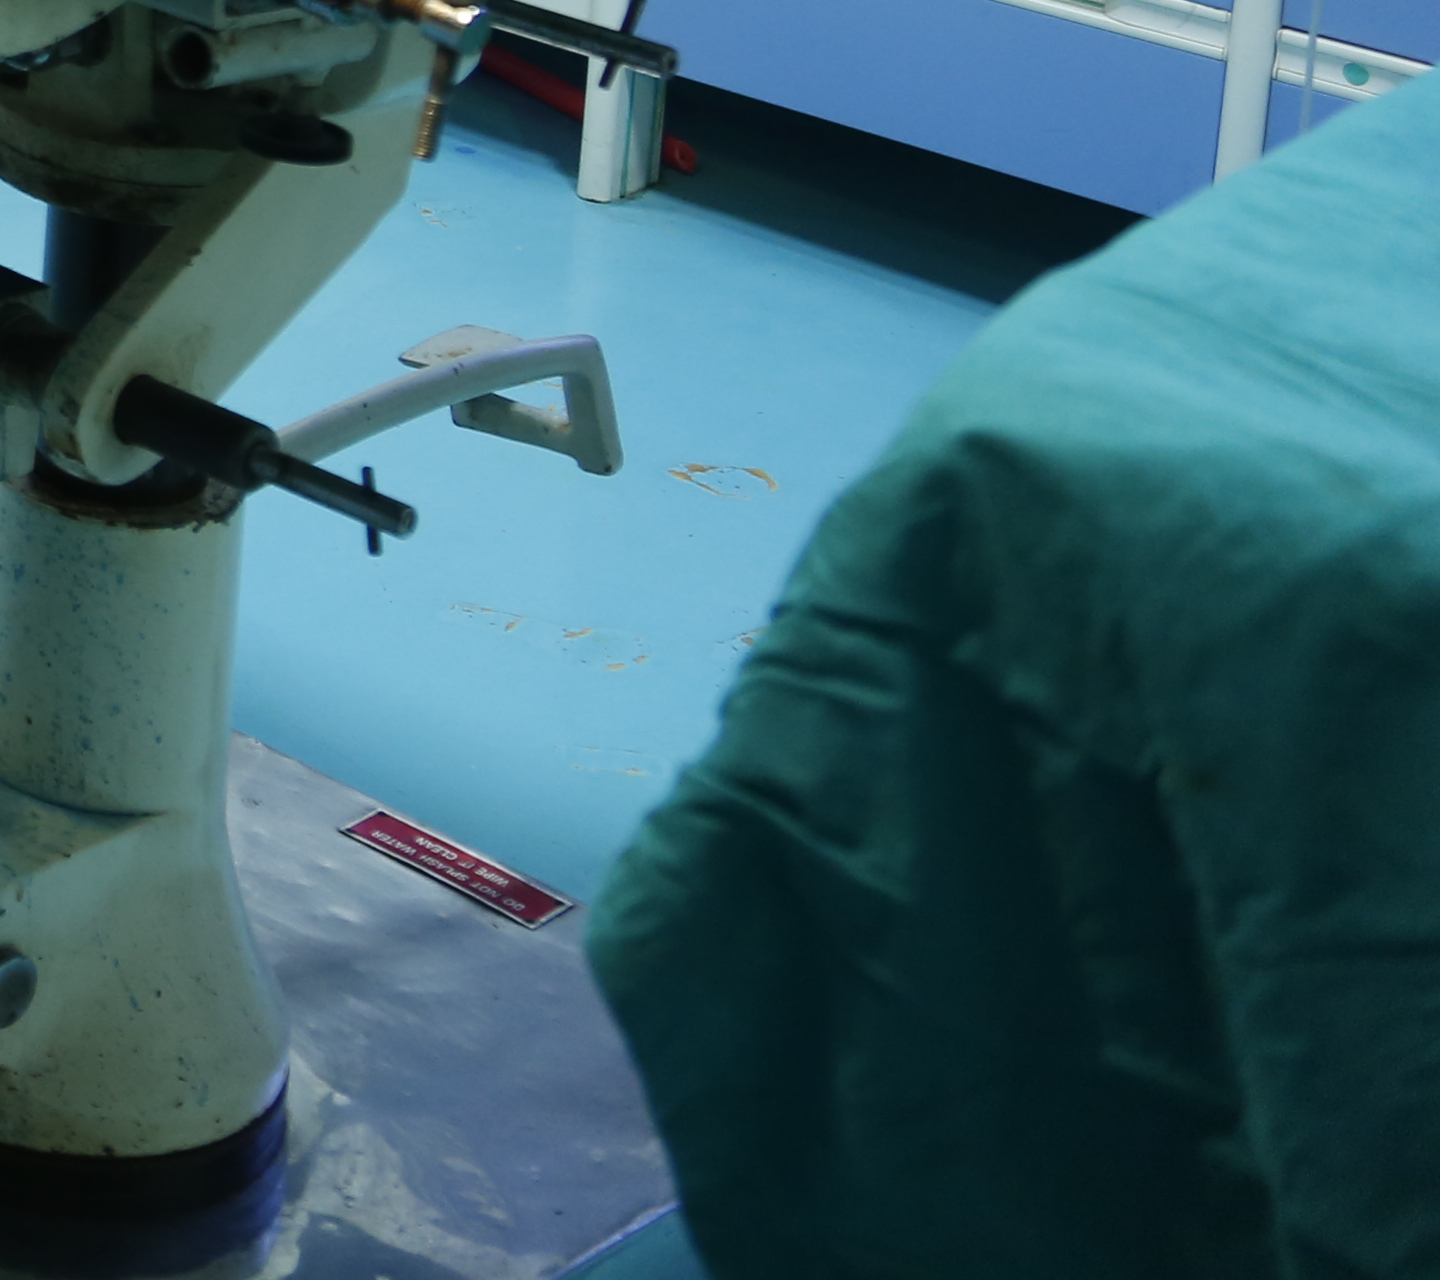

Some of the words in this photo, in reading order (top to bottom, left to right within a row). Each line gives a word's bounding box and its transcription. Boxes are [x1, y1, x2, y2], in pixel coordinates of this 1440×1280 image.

[371, 830, 417, 856] WATER
[415, 836, 458, 861] CLEAN
[418, 854, 470, 882] SPLASH
[474, 867, 510, 888] WIPE
[470, 881, 500, 899] NOT
[503, 897, 526, 912] DO
